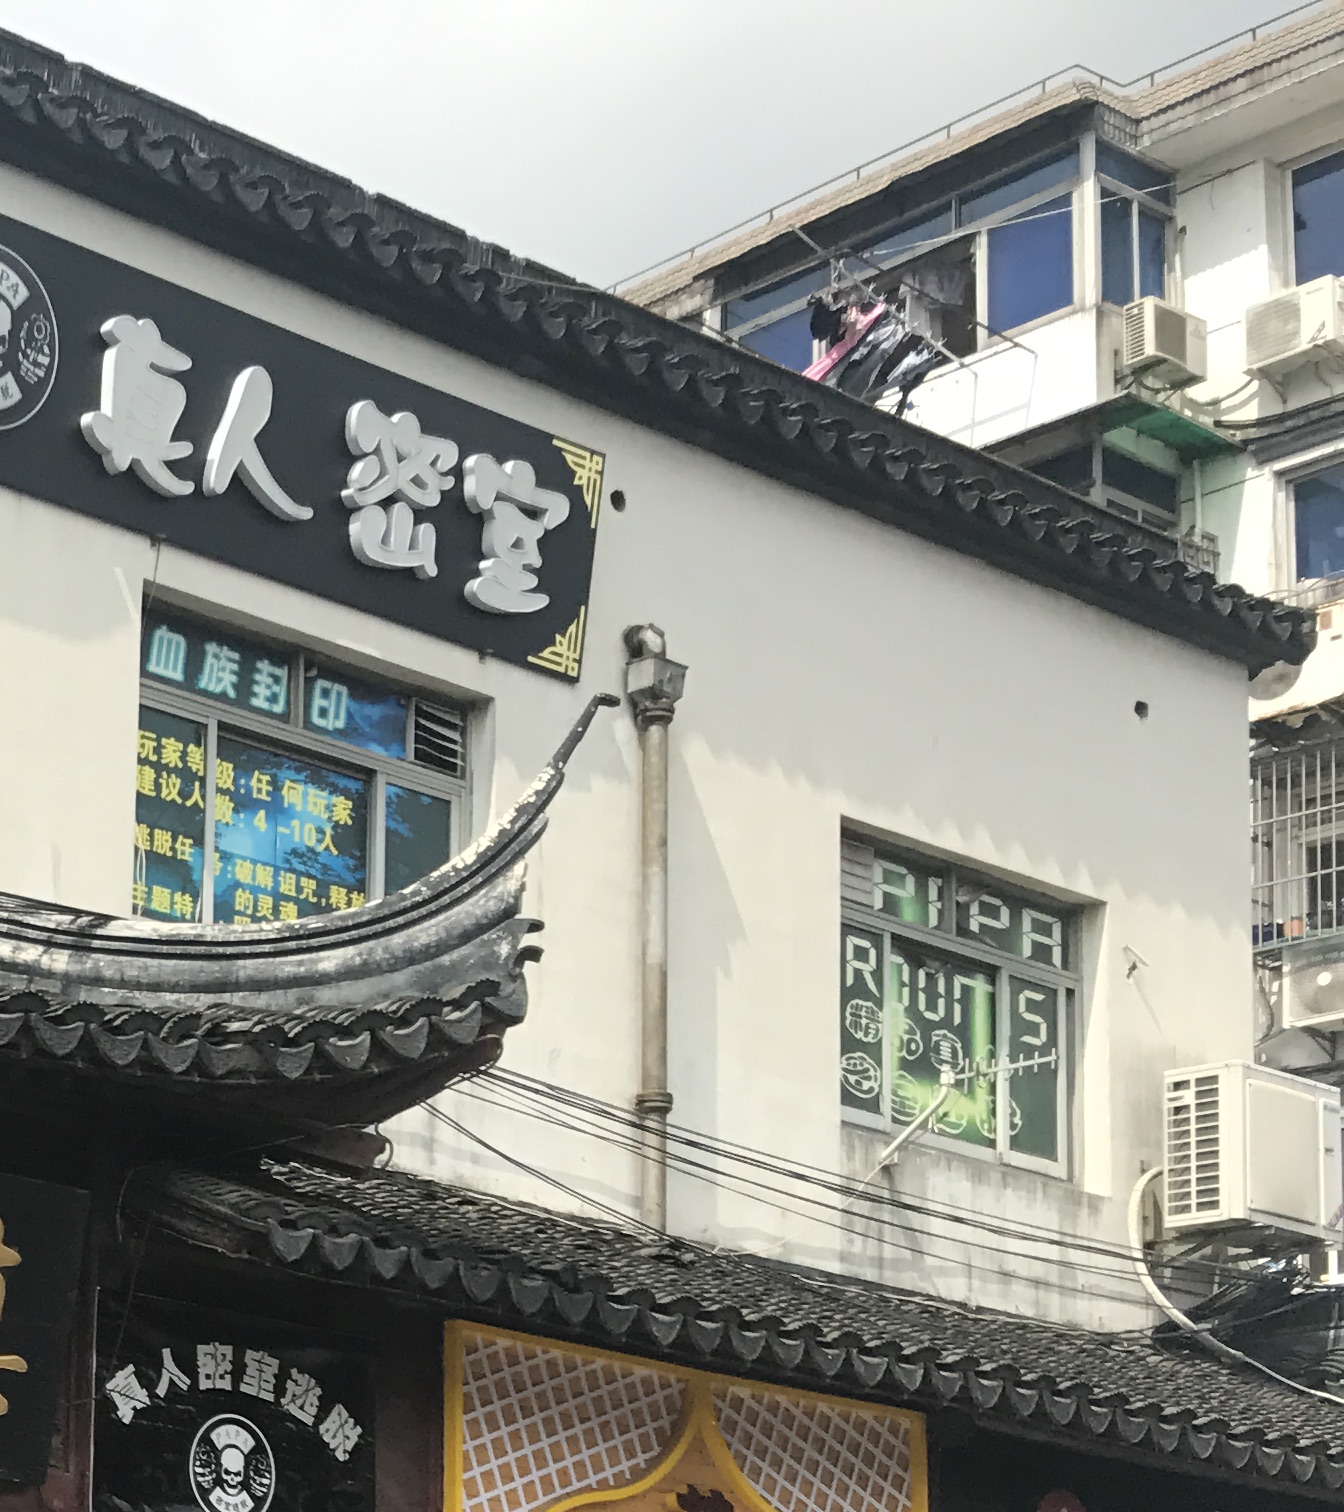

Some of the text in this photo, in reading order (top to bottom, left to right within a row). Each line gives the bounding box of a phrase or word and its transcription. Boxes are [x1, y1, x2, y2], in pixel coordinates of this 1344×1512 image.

[80, 315, 570, 614] 真人密室
[146, 624, 348, 731] 血族封印
[105, 1342, 362, 1461] 真人密室逃脱
